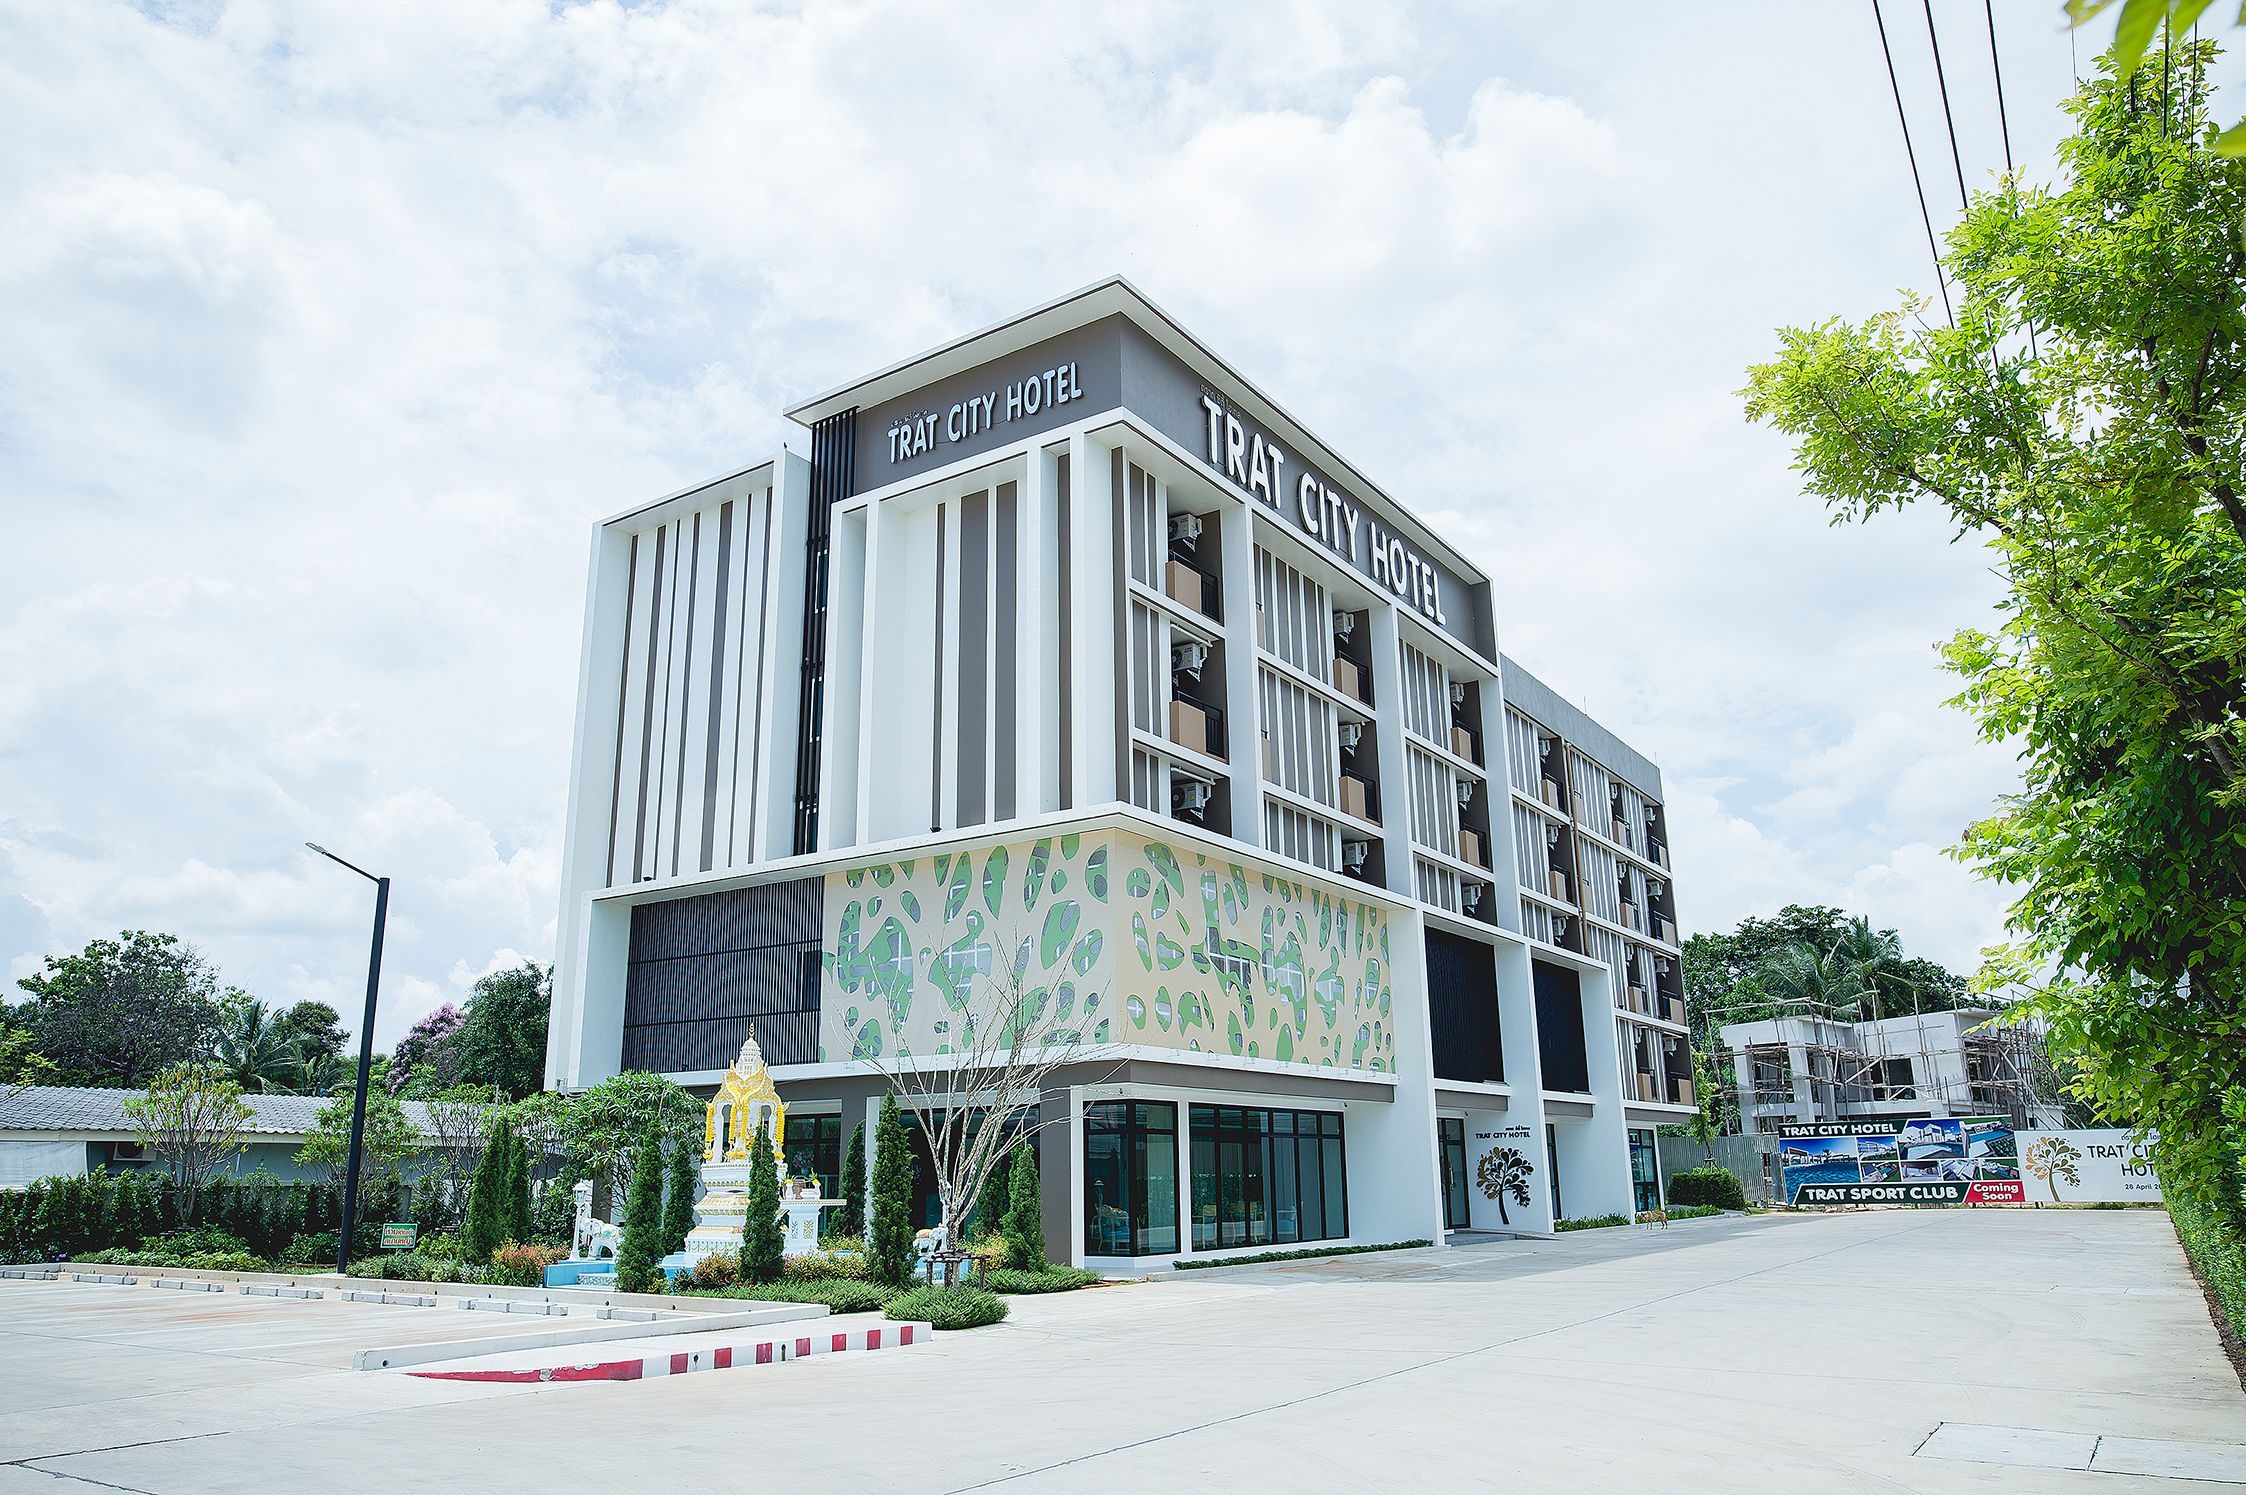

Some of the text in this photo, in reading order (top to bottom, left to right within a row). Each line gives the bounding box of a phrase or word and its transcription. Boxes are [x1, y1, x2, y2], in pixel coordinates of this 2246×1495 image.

[887, 361, 1083, 464] TRAT CITY HOTEL
[1202, 394, 1447, 626] TRAT CITY HOTEL
[1782, 1122, 1898, 1137] TRAT CITY HOTEL
[2086, 1145, 2125, 1158] TRAT
[1805, 1185, 1959, 1201] TRAT SPORT CLUB
[1973, 1182, 2019, 1195] Coming
[2136, 1183, 2153, 1191] April
[1982, 1191, 2013, 1201] Soon
